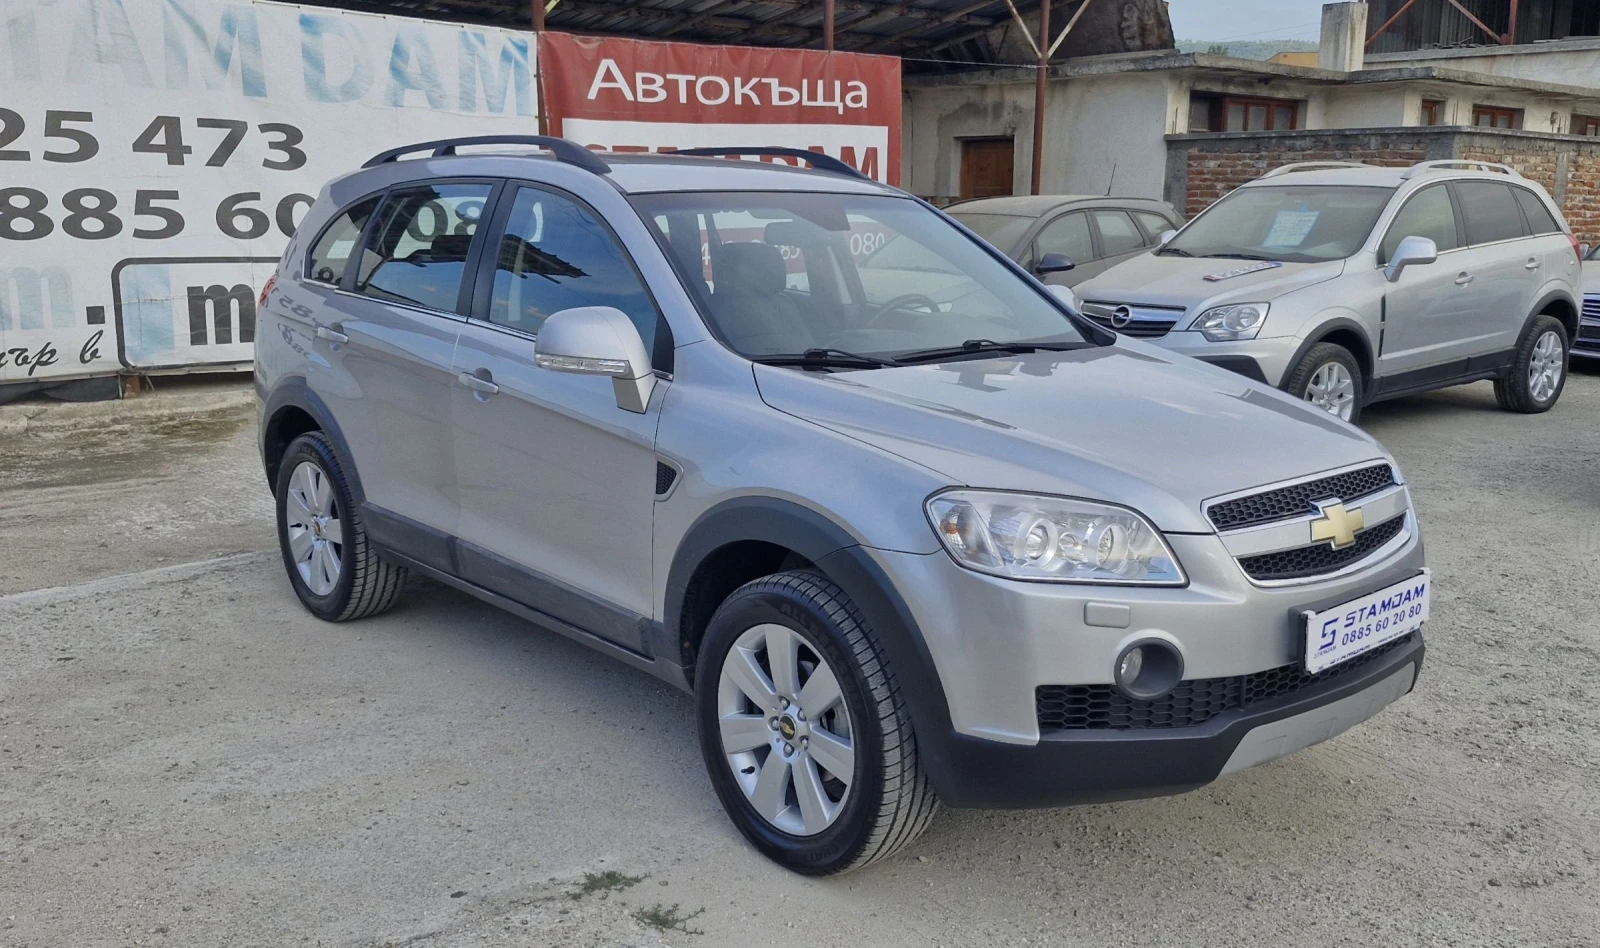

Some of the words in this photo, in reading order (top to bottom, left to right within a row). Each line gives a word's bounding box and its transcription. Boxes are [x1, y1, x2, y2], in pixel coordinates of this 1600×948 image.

[587, 58, 868, 115] Автокъща
[131, 114, 308, 172] 473
[1341, 624, 1372, 646] 0885
[1375, 617, 1389, 632] 60
[1392, 611, 1406, 625] 20
[1408, 603, 1422, 618] 80
